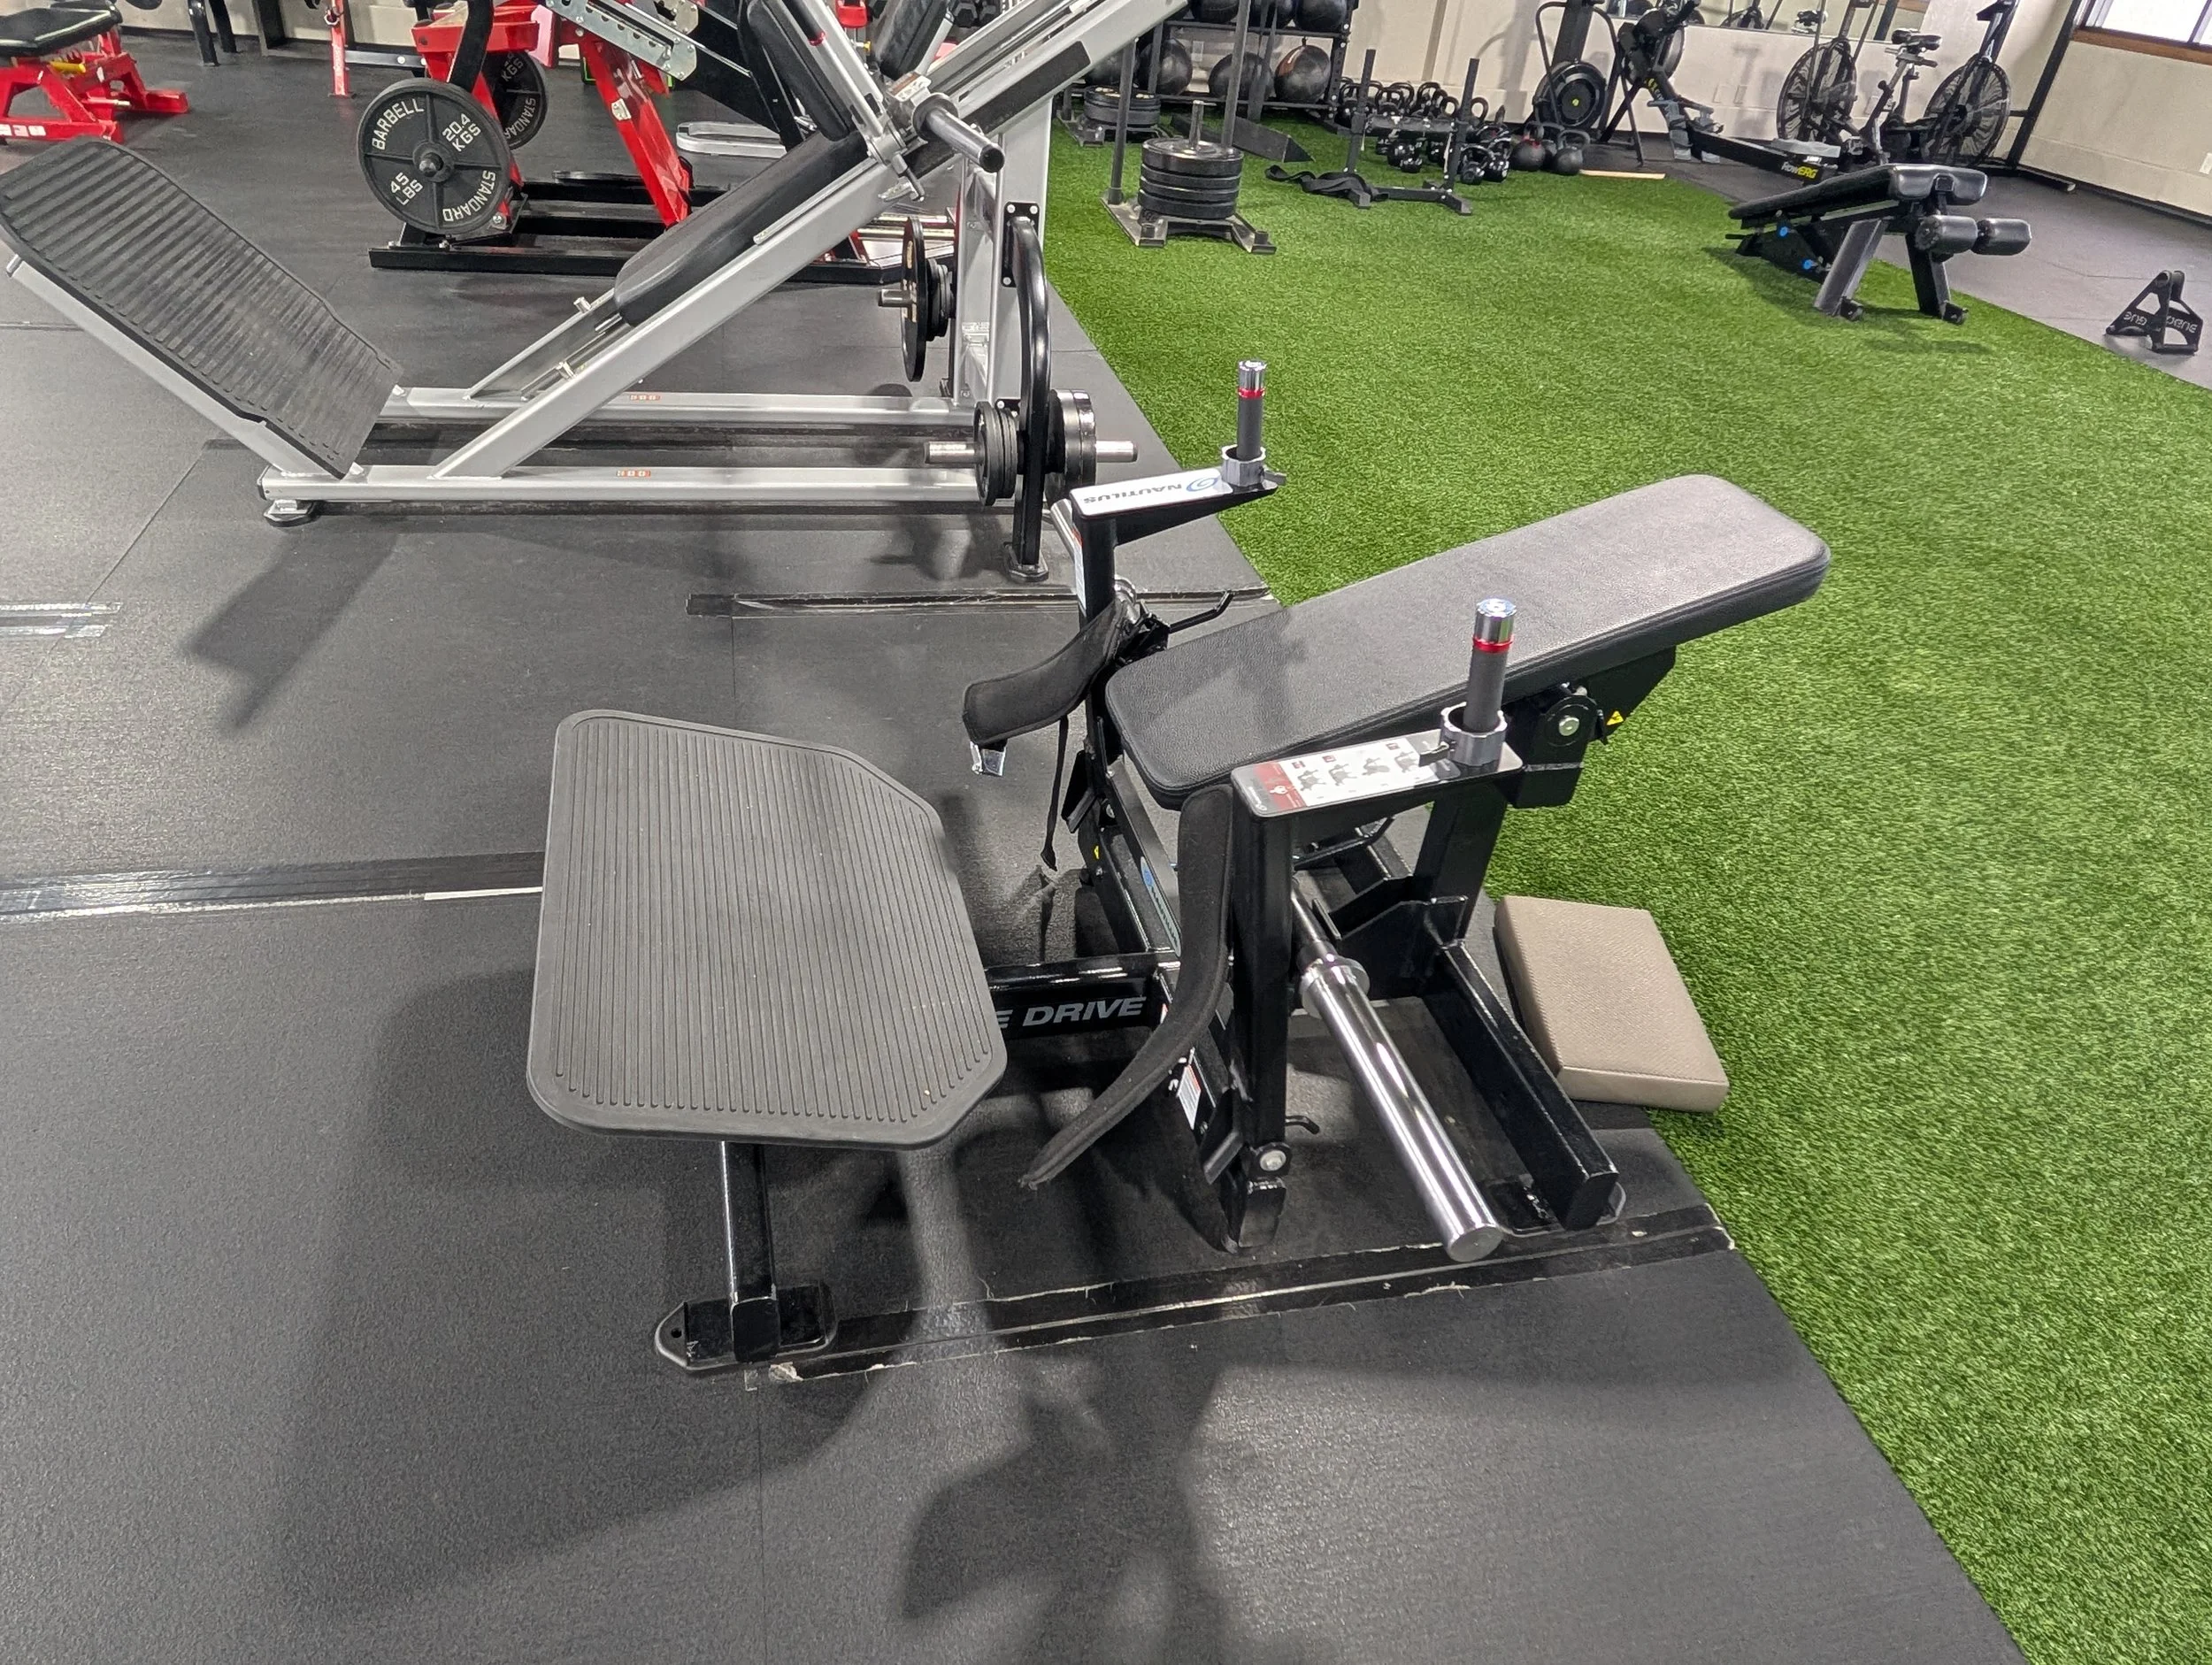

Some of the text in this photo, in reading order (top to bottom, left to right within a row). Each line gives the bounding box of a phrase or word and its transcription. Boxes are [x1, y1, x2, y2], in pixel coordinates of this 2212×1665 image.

[501, 57, 525, 82] KGS
[371, 98, 425, 150] BARBELL
[442, 112, 472, 142] 20.4
[451, 122, 481, 152] KGS
[389, 172, 410, 194] 45
[396, 179, 424, 206] LBS
[442, 170, 496, 222] STANDARD
[1083, 482, 1182, 504] NAUTILUS
[1022, 995, 1147, 1027] DRIVE
